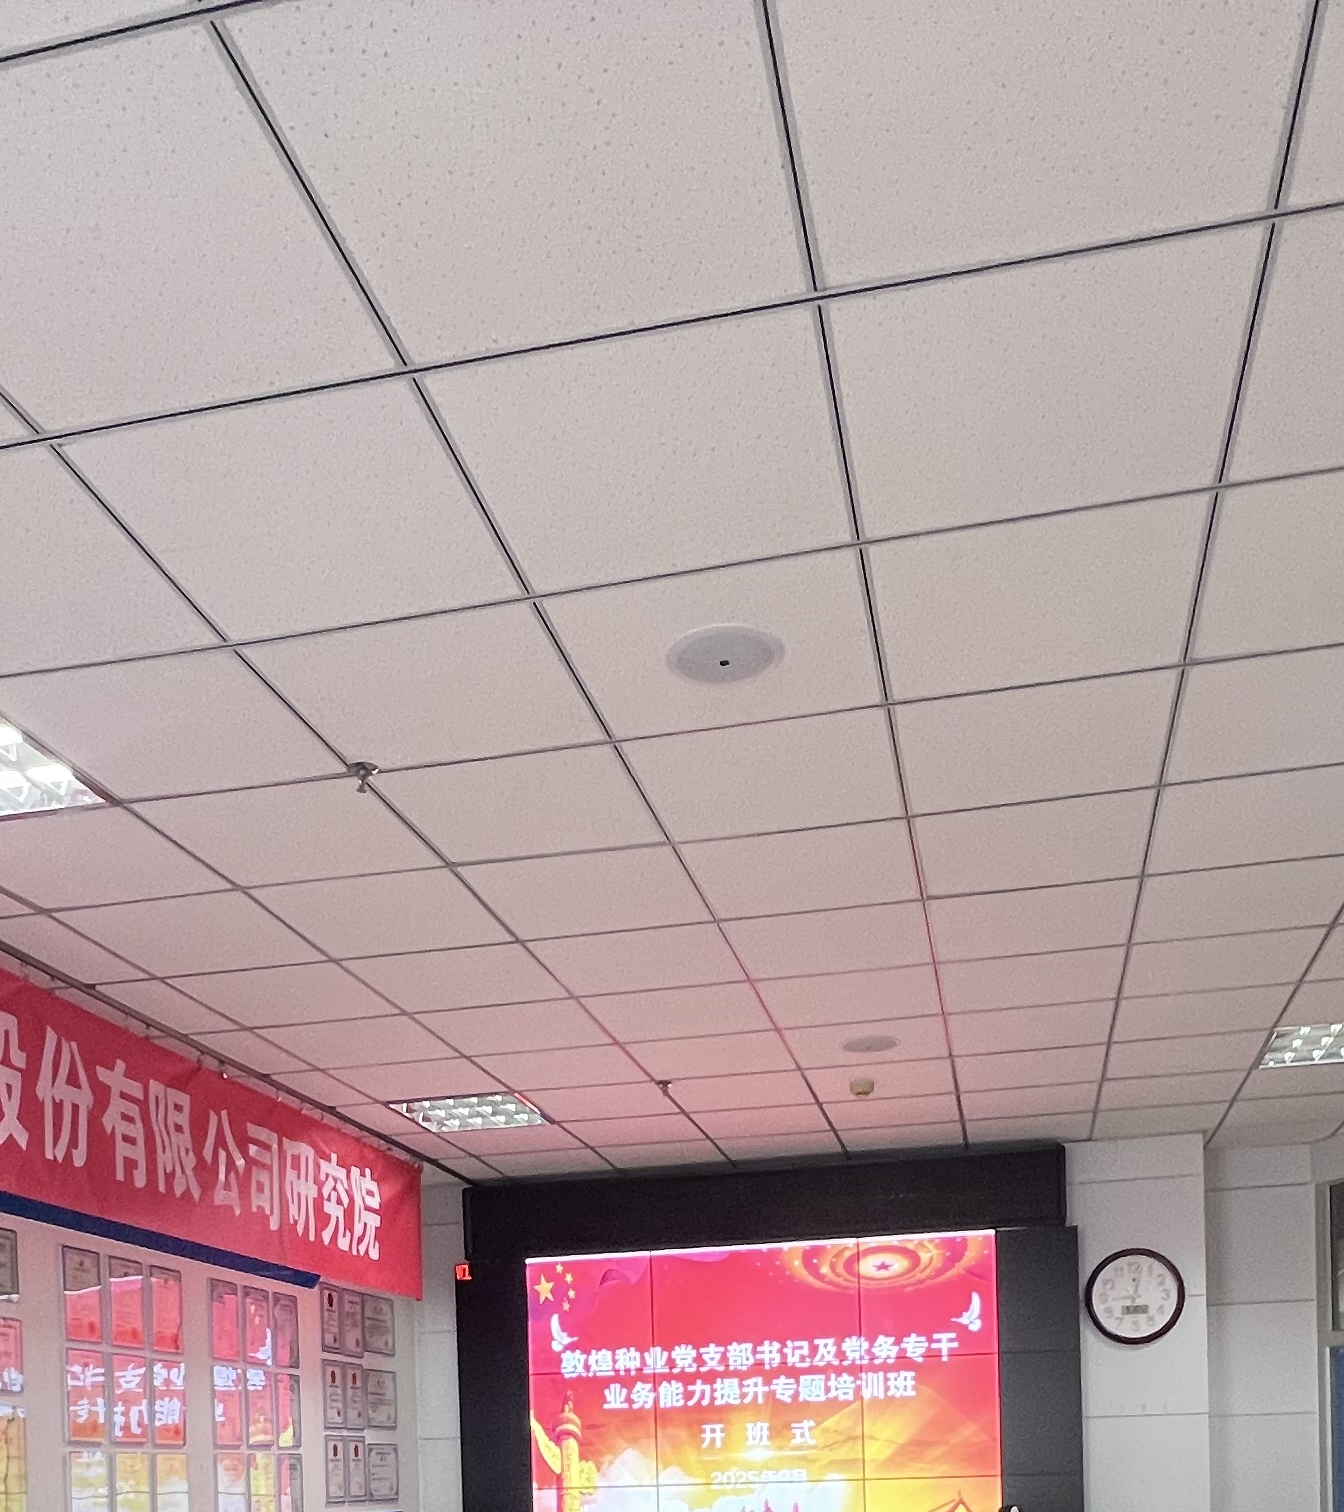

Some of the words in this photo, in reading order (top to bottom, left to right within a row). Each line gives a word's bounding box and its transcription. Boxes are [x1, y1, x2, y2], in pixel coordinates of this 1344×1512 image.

[560, 1331, 959, 1379] 敦煌种业党支部书记及党务专干
[602, 1370, 917, 1411] 业务能力提升专题培训班
